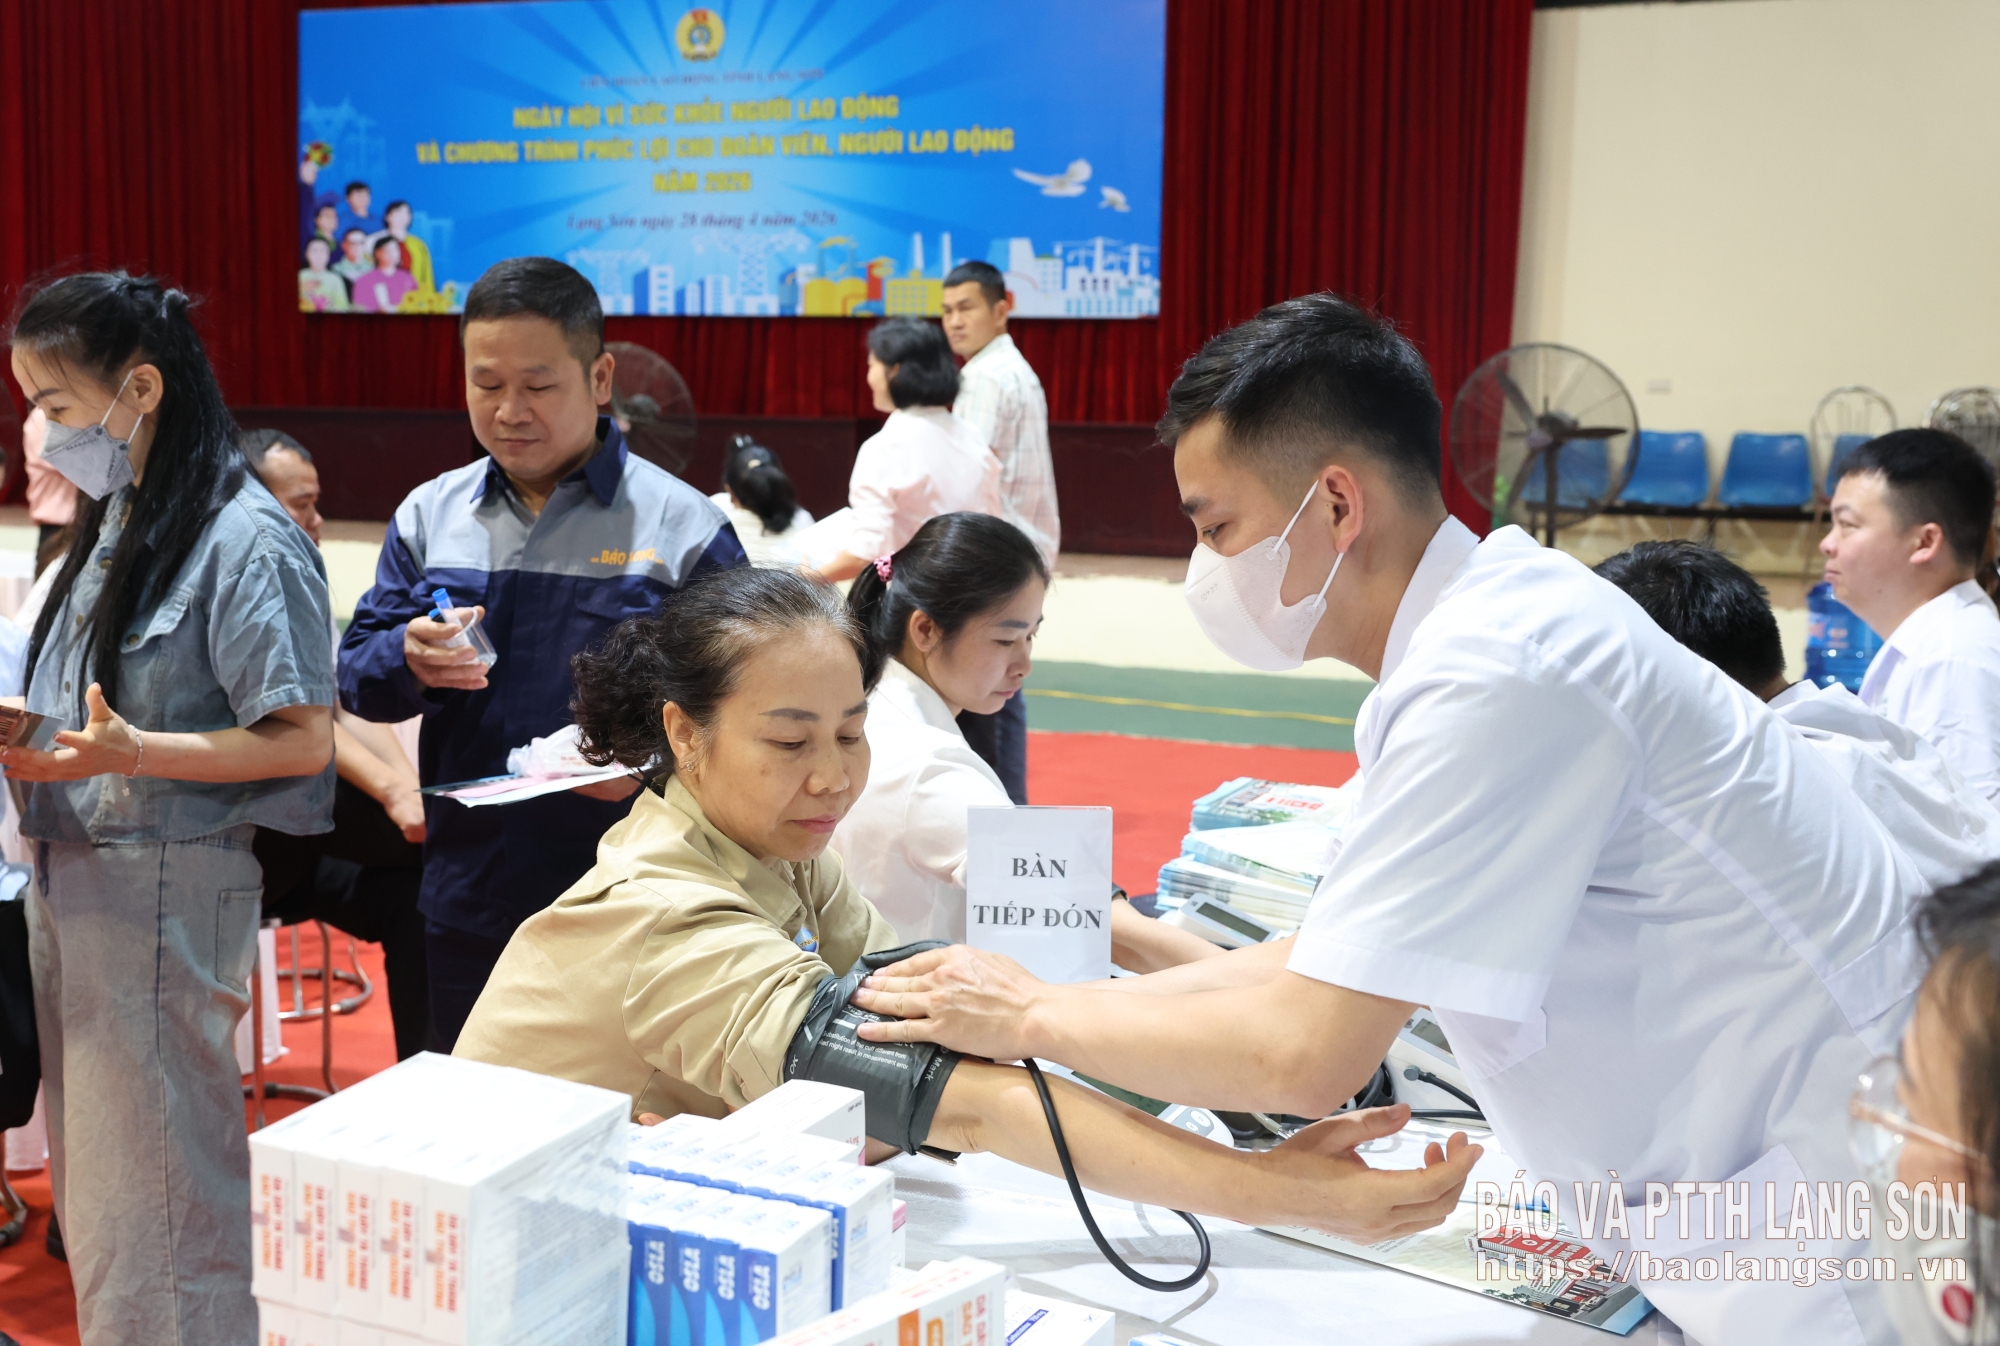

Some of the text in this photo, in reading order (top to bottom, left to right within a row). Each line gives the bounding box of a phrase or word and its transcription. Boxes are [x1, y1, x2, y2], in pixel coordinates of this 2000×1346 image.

[798, 98, 836, 121] LAO
[416, 138, 440, 163] VÀ
[909, 129, 949, 153] LAO
[954, 124, 1015, 156] ĐỘNG
[1011, 853, 1068, 879] BÀN
[973, 901, 1103, 929] TIẾP ĐÓN
[925, 1057, 943, 1081] Mark
